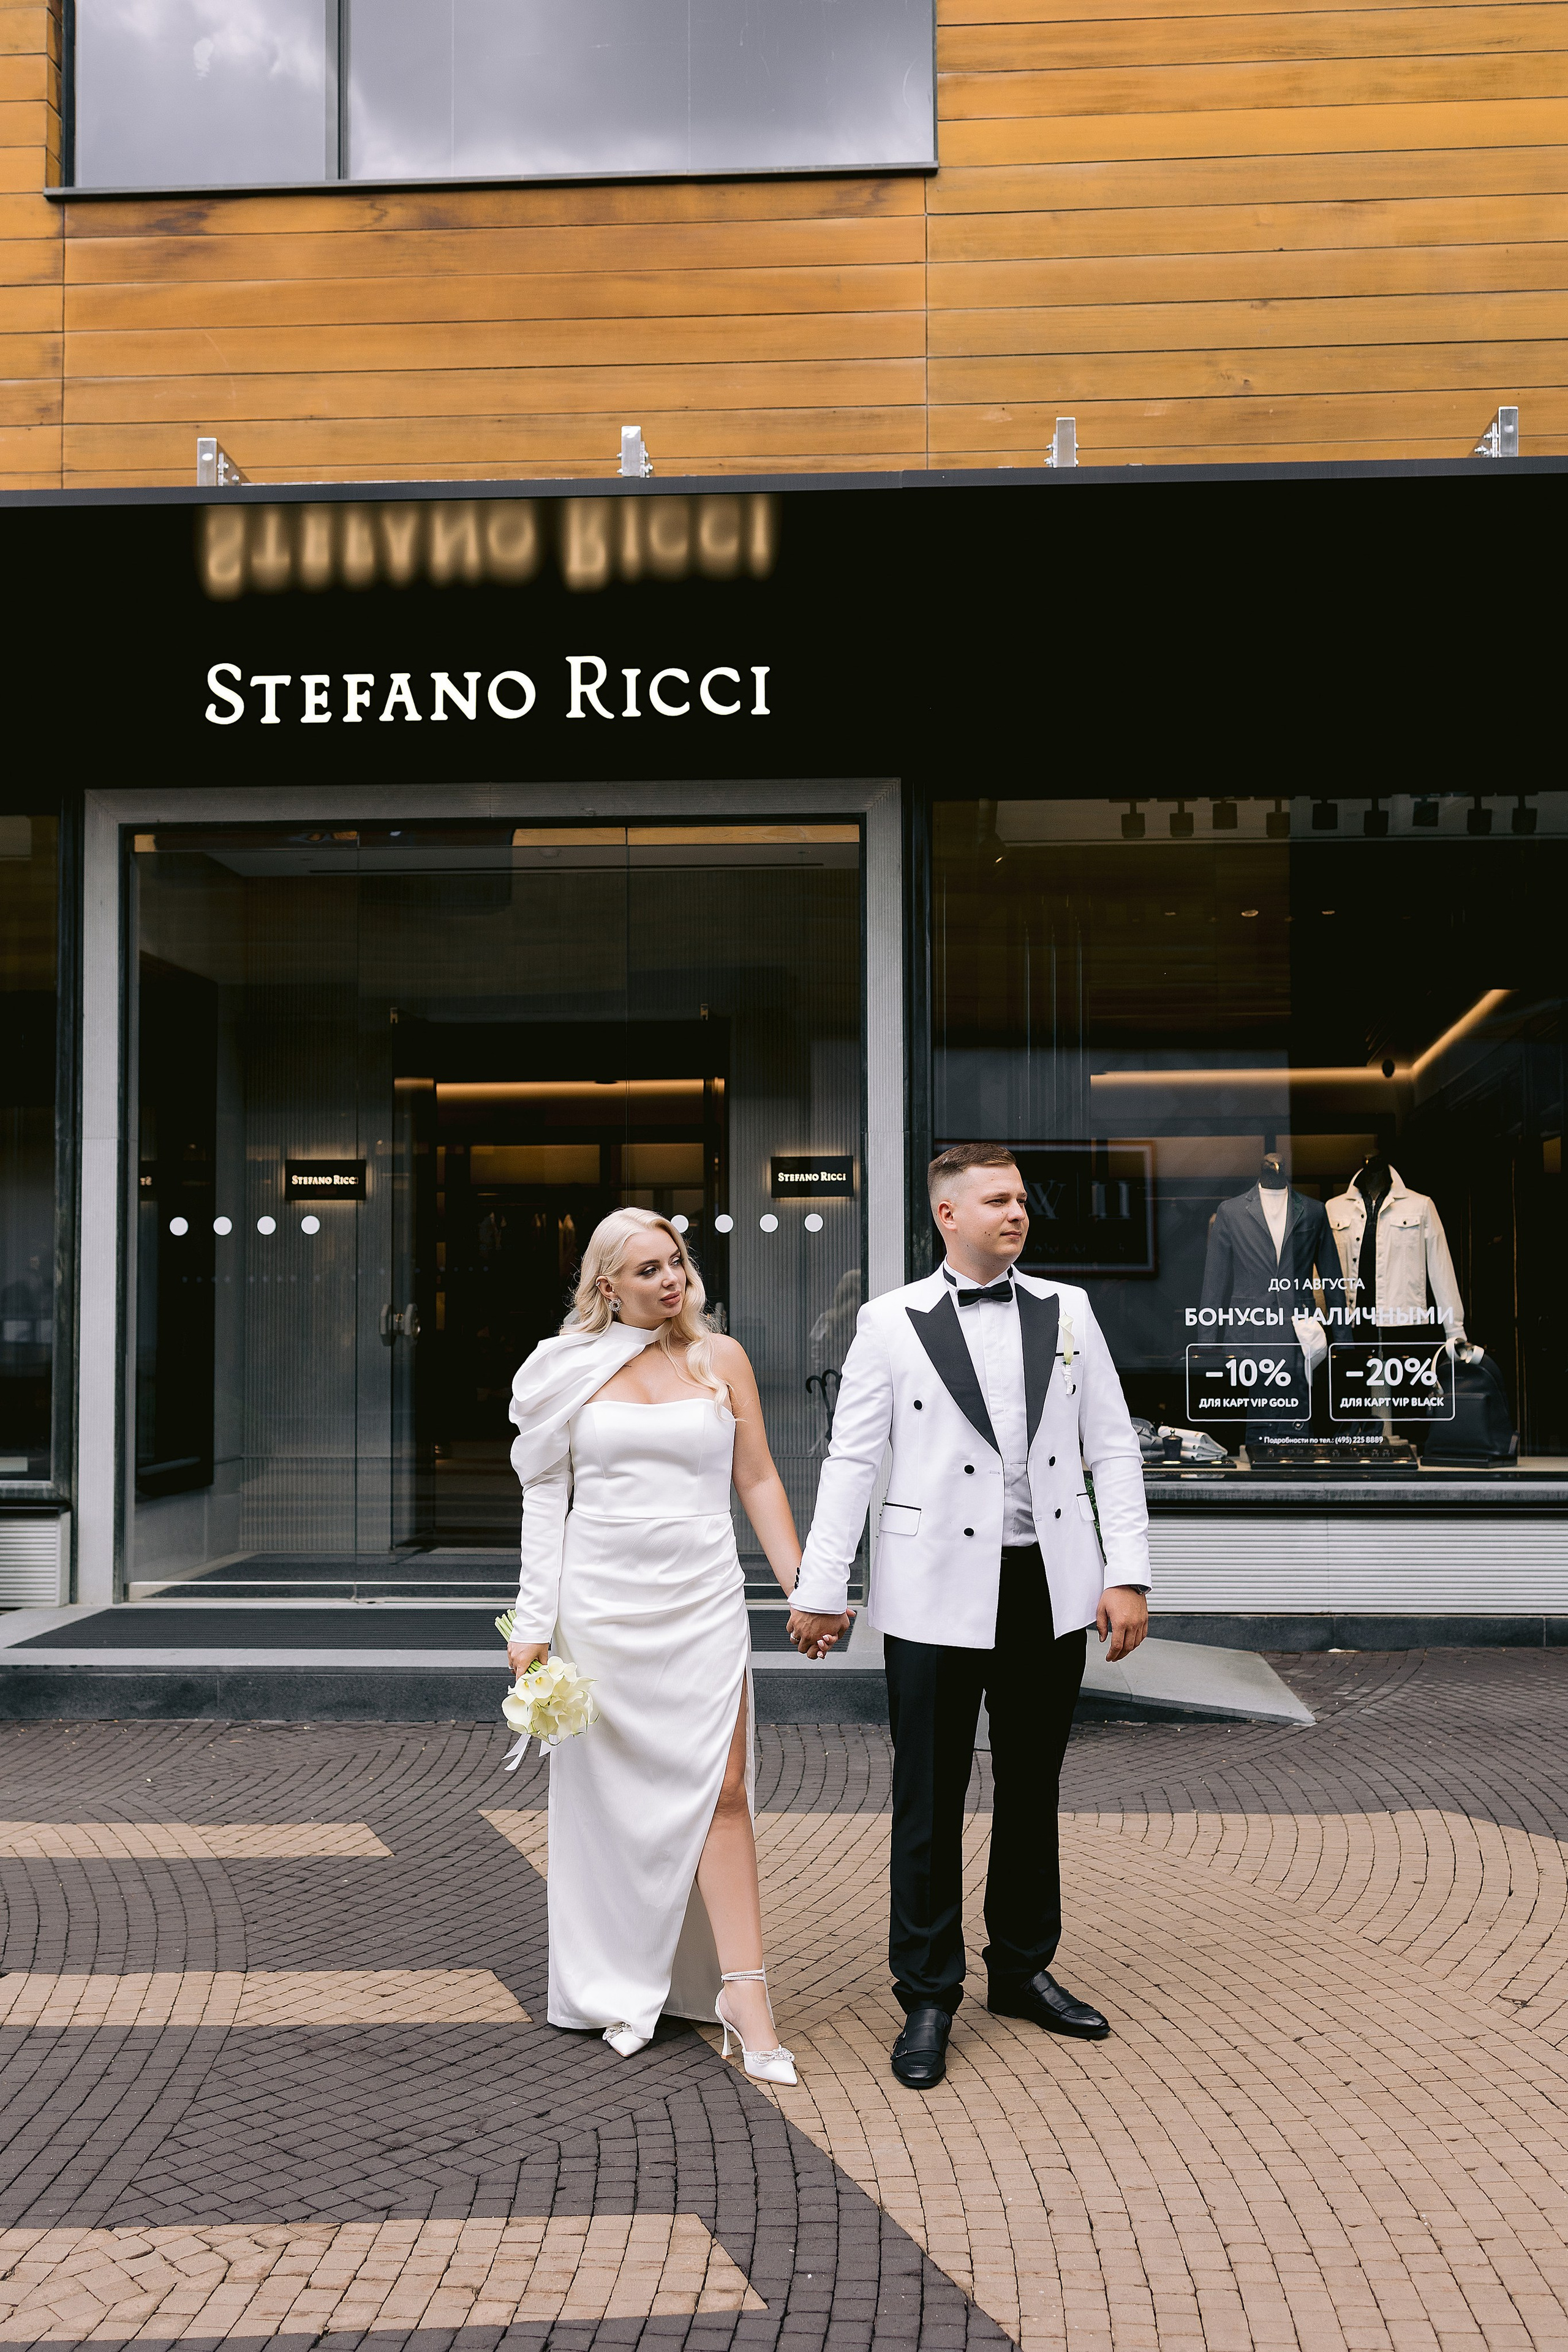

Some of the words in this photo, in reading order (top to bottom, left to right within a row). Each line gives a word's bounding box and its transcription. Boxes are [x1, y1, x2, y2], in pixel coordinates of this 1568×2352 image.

[205, 663, 536, 725] STEFANO
[565, 655, 771, 719] RICCI
[292, 1175, 333, 1185] STEFANO
[778, 1172, 819, 1182] STEFANO
[820, 1171, 846, 1182] RICCI
[1268, 1278, 1291, 1292] ДО
[1294, 1278, 1299, 1291] 1
[1302, 1277, 1365, 1291] АВГУСТА
[1185, 1307, 1284, 1327] БОНУСЫ
[1294, 1306, 1455, 1326] НАЛИЧНЫМИ
[1199, 1398, 1221, 1409] ДЛЯ
[1223, 1398, 1250, 1408] КАРТ
[1250, 1398, 1268, 1408] VIP
[1268, 1397, 1299, 1408] GOLD
[1340, 1397, 1362, 1408] ДЛЯ
[1364, 1397, 1391, 1407] КАРТ
[1392, 1397, 1409, 1407] VIP
[1411, 1397, 1444, 1407] BLACK
[1264, 1436, 1309, 1444] Подробности
[1335, 1436, 1352, 1445] (495)
